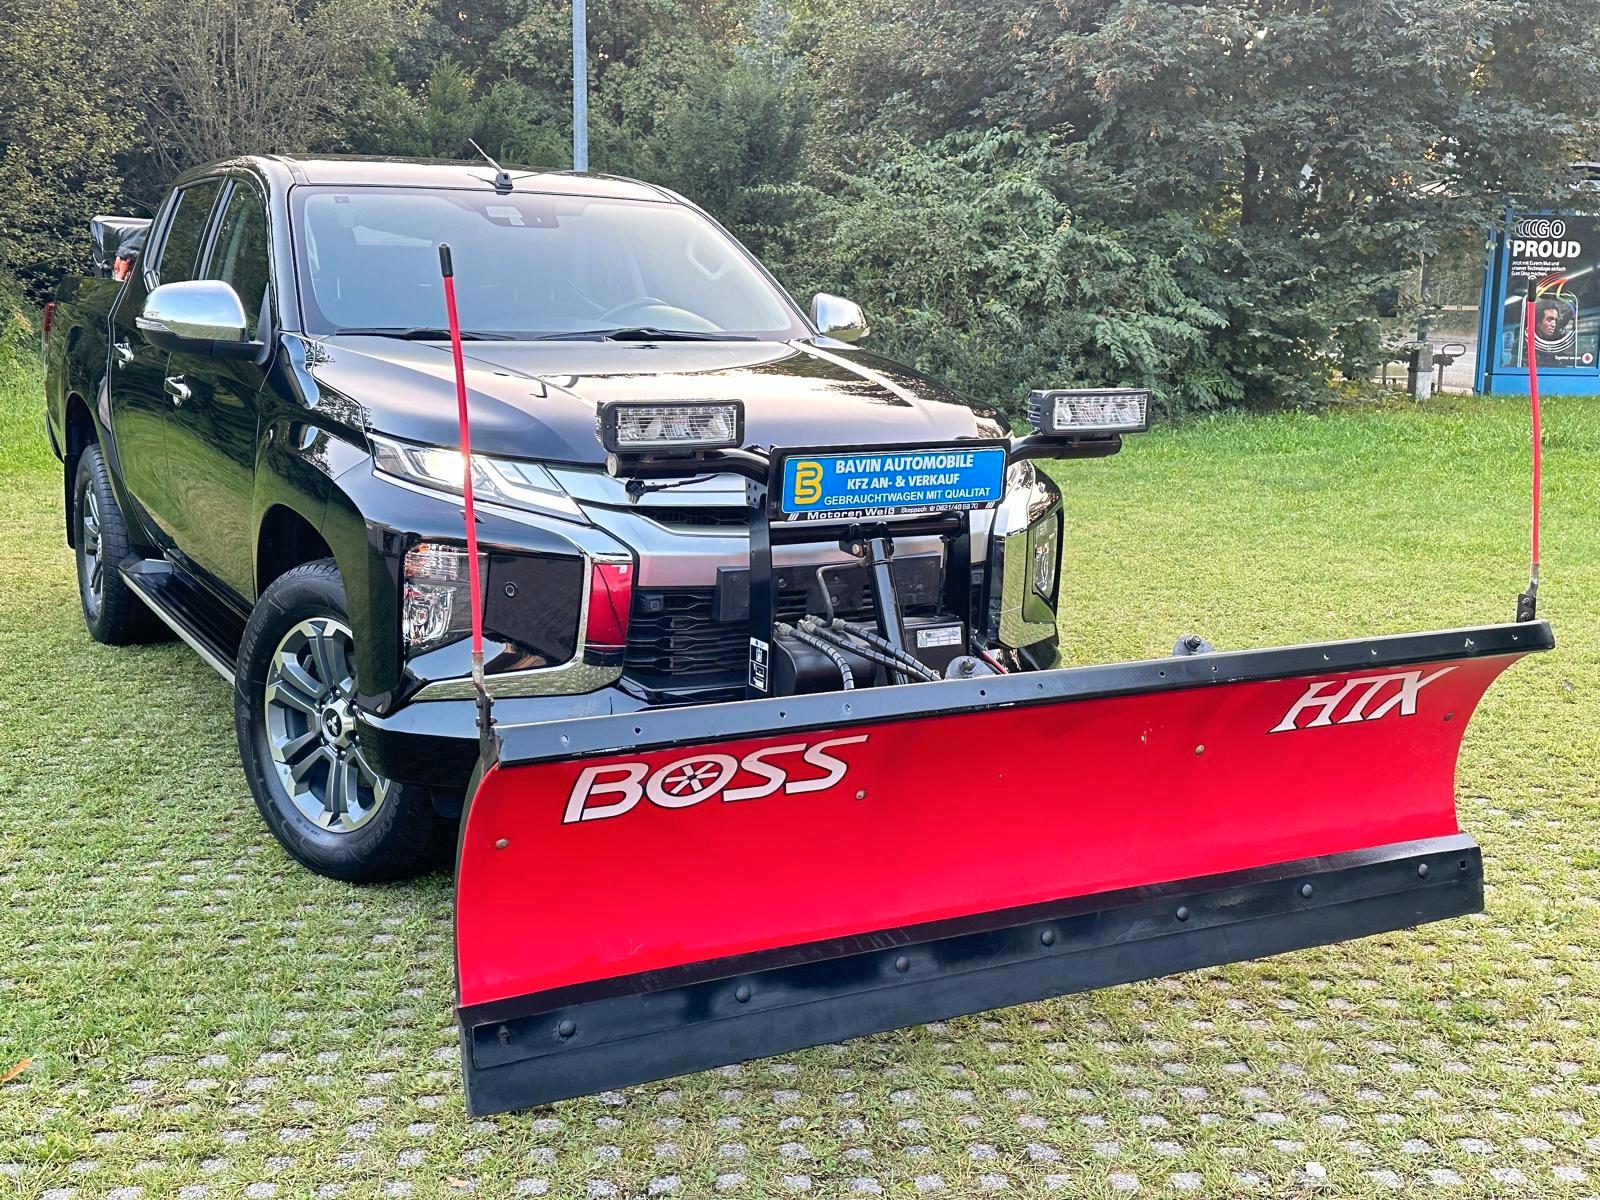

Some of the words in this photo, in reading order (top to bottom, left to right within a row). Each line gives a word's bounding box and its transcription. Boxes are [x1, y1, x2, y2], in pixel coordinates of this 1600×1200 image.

[1513, 240, 1581, 258] PROUD
[835, 458, 880, 474] BAVIN
[883, 454, 975, 472] AUTOMOBILE
[846, 477, 869, 490] KFZ
[870, 477, 893, 489] AN-
[895, 475, 906, 488] &
[908, 473, 961, 487] VERKAUF
[824, 491, 924, 506] GEBRAUCHTWAGEN
[926, 489, 943, 500] MIT
[807, 510, 862, 520] Motoren
[1264, 665, 1460, 735] HTX
[562, 733, 870, 826] BOSS
